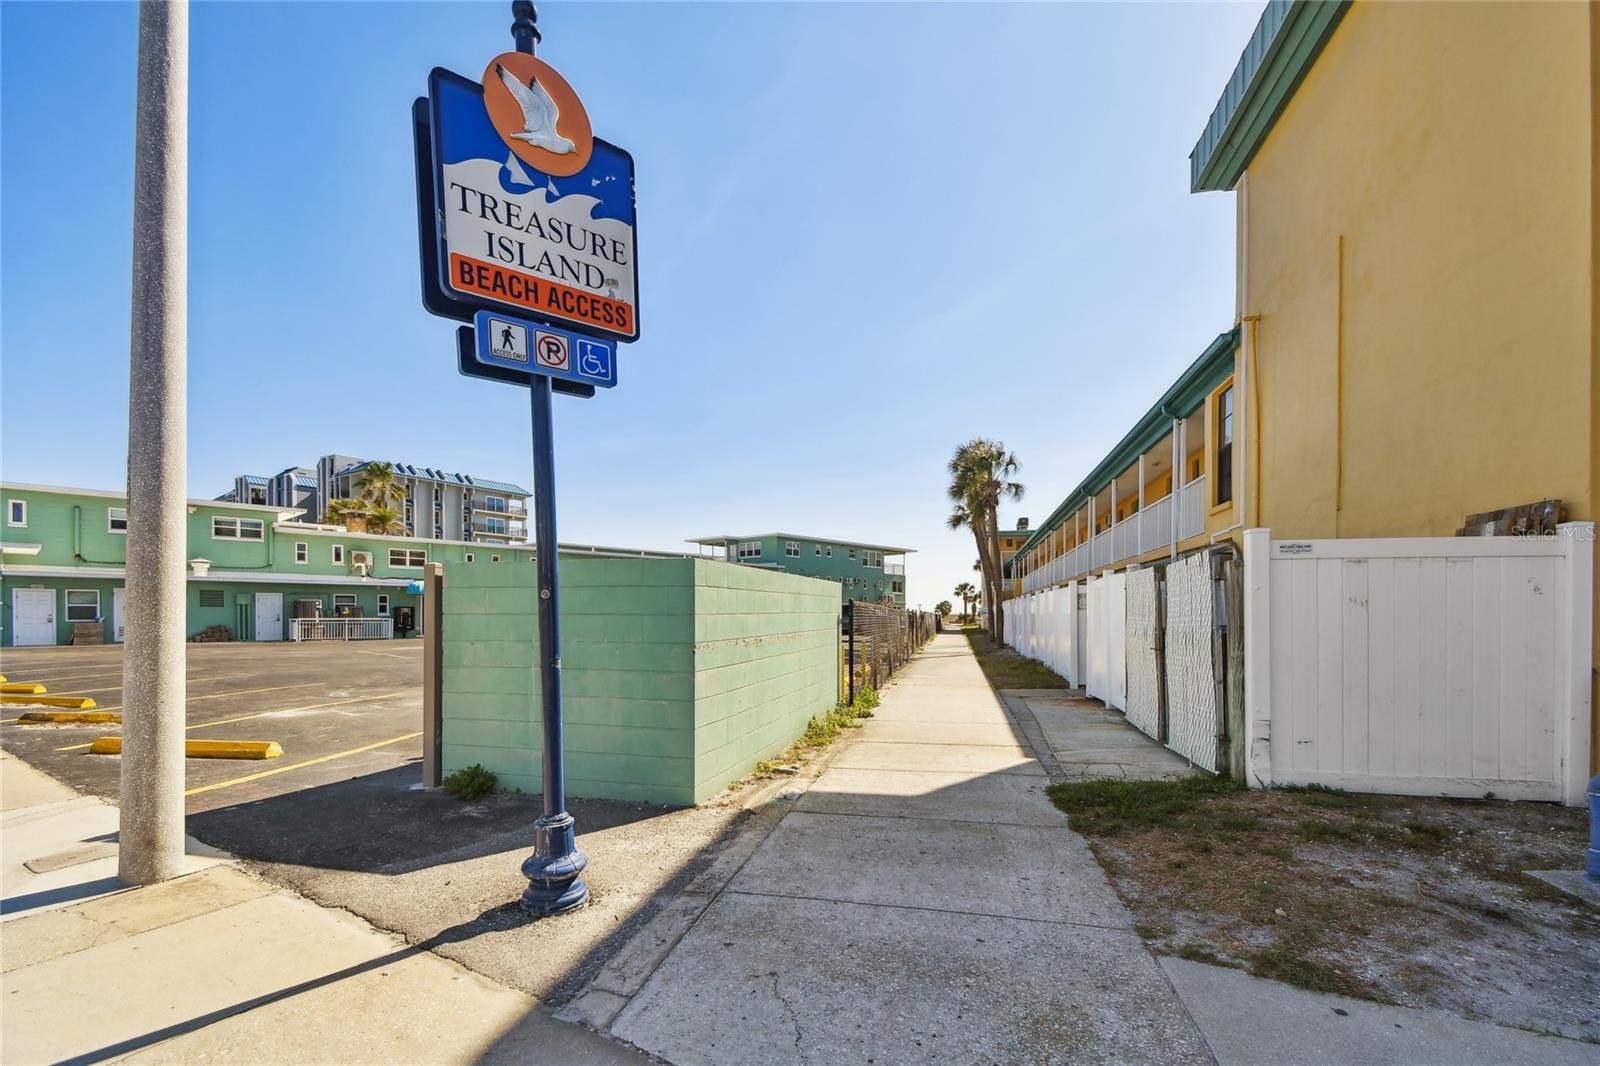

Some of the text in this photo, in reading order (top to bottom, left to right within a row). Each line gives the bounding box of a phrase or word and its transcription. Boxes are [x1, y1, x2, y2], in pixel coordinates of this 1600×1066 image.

[450, 182, 627, 266] TREASURE
[483, 230, 605, 290] ISLAND
[459, 260, 627, 328] BEACH ACCESS
[493, 347, 526, 361] ACCESS ONLY
